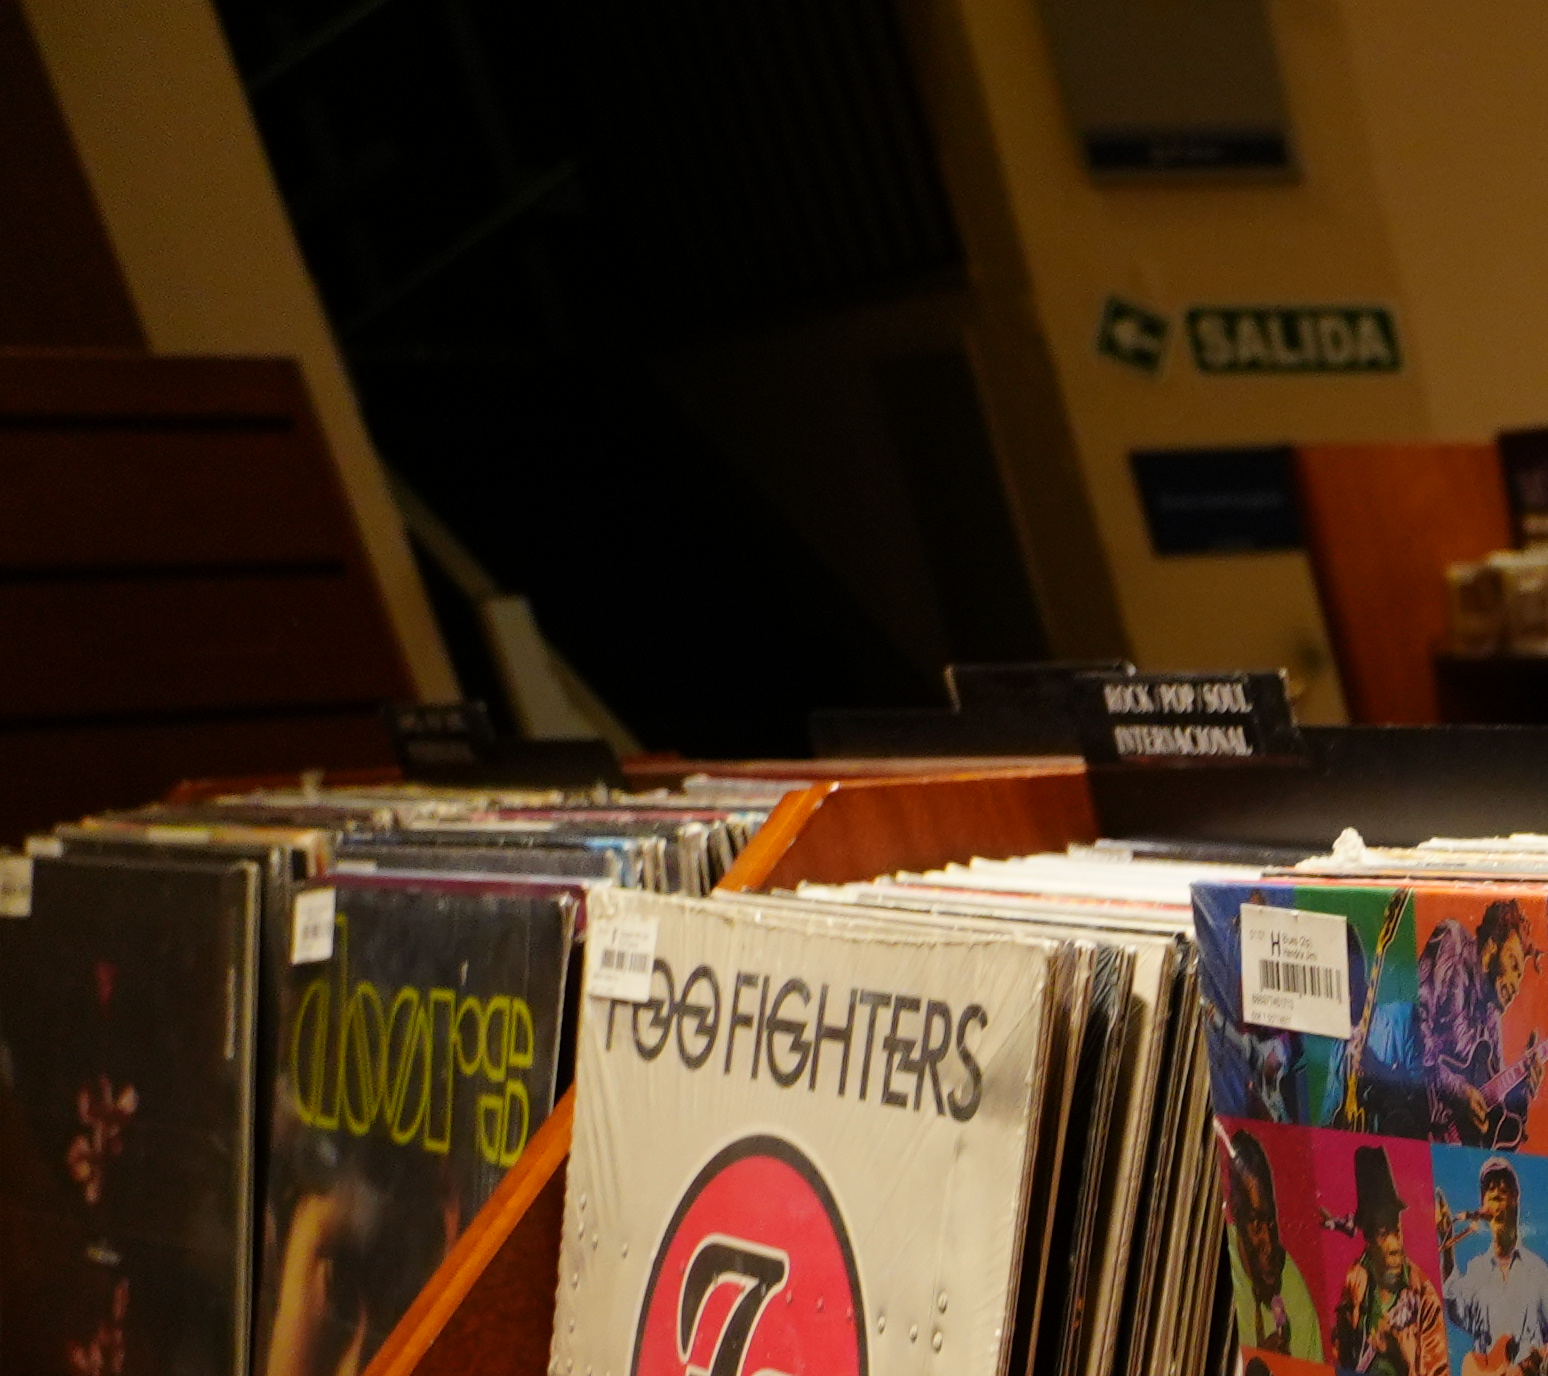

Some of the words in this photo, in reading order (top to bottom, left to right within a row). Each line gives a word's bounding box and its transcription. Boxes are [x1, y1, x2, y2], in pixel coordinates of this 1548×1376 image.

[1196, 313, 1392, 366] SALIDA
[1104, 682, 1154, 714] ROCK
[1160, 683, 1195, 714] POP
[1202, 683, 1253, 714] SOUL
[1113, 724, 1253, 757] INTERNACIONAL
[1271, 930, 1281, 957] H
[723, 963, 989, 1123] FIGHTERS
